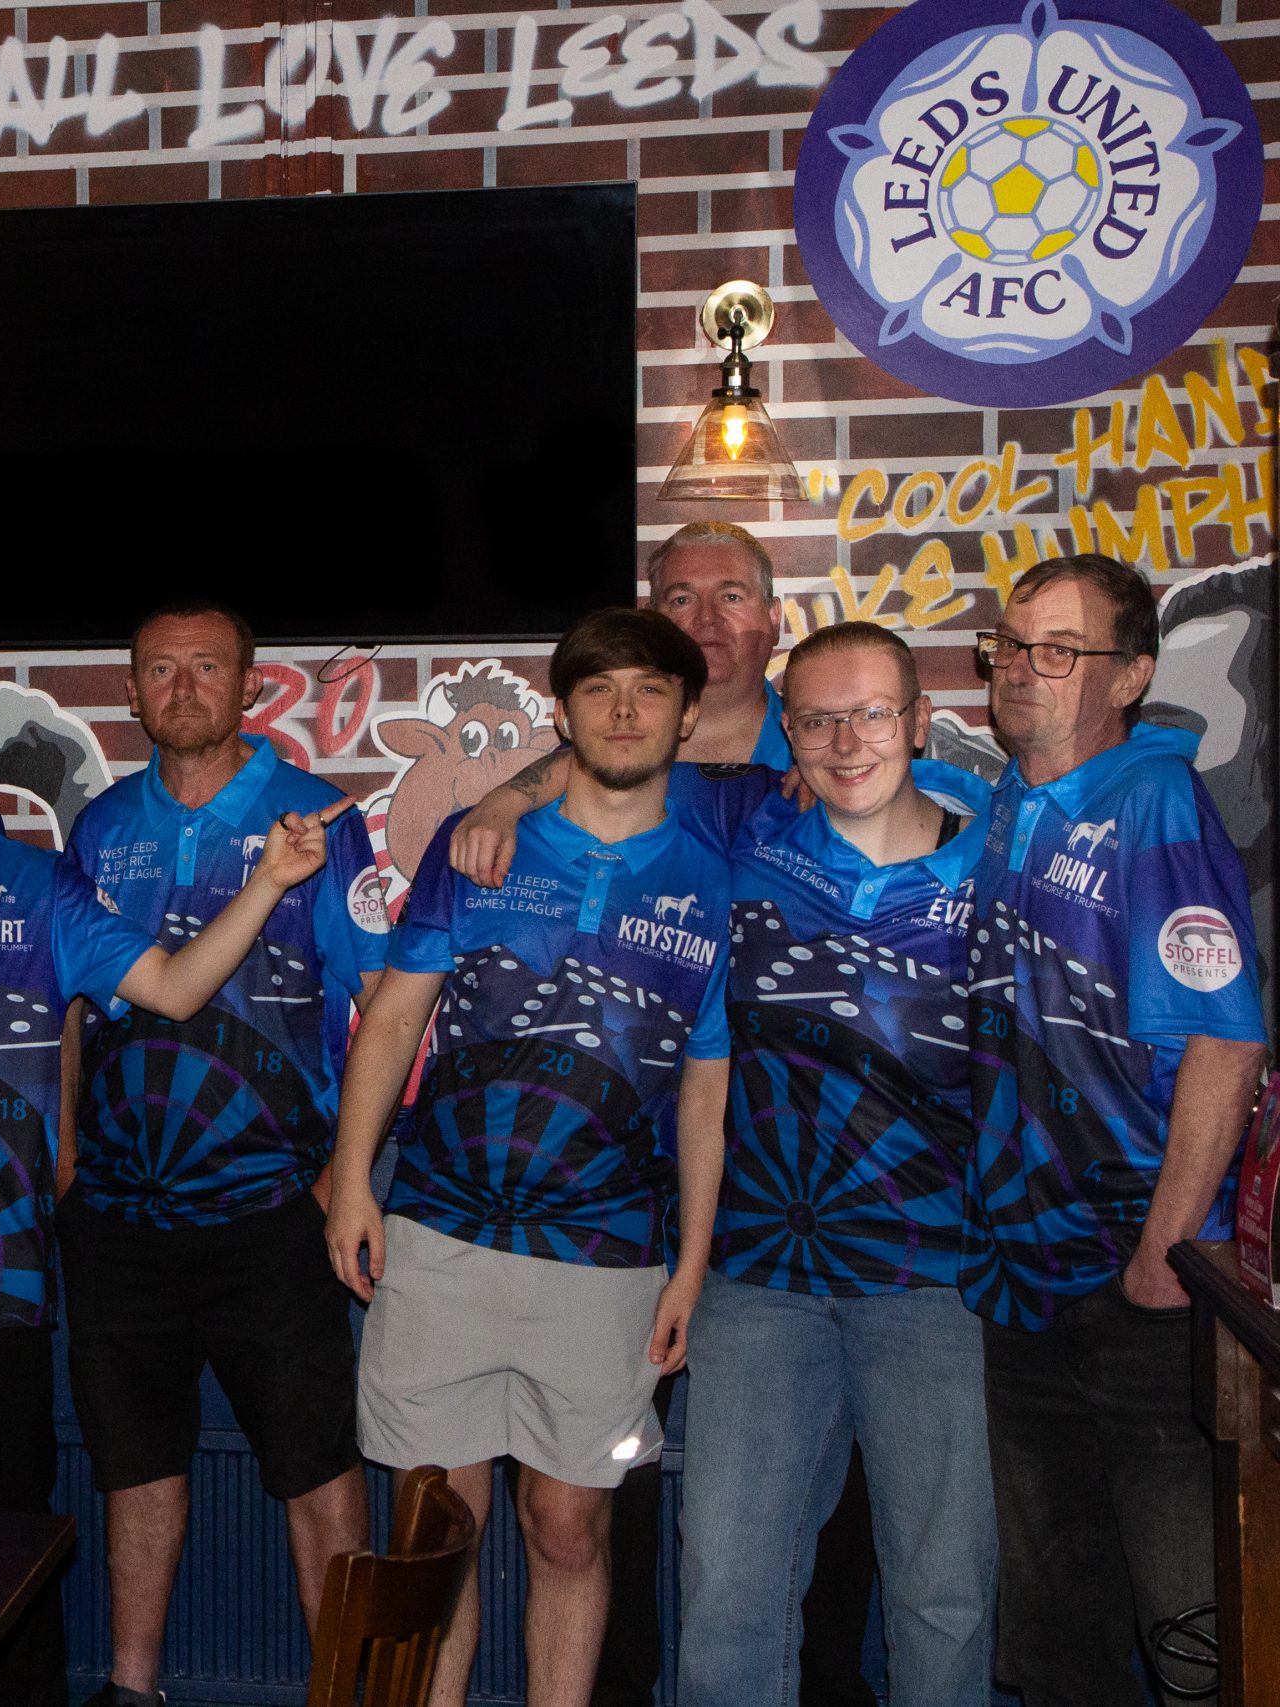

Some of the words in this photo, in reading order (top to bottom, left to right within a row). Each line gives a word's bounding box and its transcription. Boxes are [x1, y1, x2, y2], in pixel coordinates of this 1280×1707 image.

[188, 17, 453, 150] LOVE
[498, 0, 828, 131] LEEDS
[882, 70, 1010, 253] LEEDS
[1046, 64, 1162, 260] UNITED
[940, 268, 1067, 319] AFC
[99, 846, 128, 859] WEST
[129, 841, 159, 853] EEDS
[103, 862, 111, 872] &
[123, 867, 162, 880] LEAGUE
[1043, 852, 1095, 894] JOHN
[1091, 870, 1108, 902] L
[210, 887, 225, 896] THE
[517, 875, 560, 891] LEEDS
[792, 865, 840, 898] LEAGUE
[465, 897, 506, 909] GAMES
[510, 900, 563, 918] LEAGUE
[1043, 882, 1065, 898] HORSE
[1064, 891, 1071, 900] &
[1074, 894, 1120, 918] TRUMPET
[910, 917, 944, 931] HORSE
[946, 926, 953, 934] &
[617, 914, 717, 966] KRYSTIAN
[617, 939, 634, 951] THE
[636, 946, 664, 960] HORSE
[665, 954, 671, 962] &
[673, 956, 710, 974] TRUMPET
[1165, 942, 1237, 965] STOFFEL
[1173, 963, 1228, 978] PRESENTS
[214, 1022, 225, 1047] 1
[747, 1011, 761, 1035] 5
[794, 1017, 830, 1047] 20
[977, 1007, 1009, 1040] 20
[255, 1049, 284, 1074] 18
[537, 1048, 575, 1077] 20
[599, 1080, 612, 1105] 1
[1047, 1081, 1080, 1117] 18
